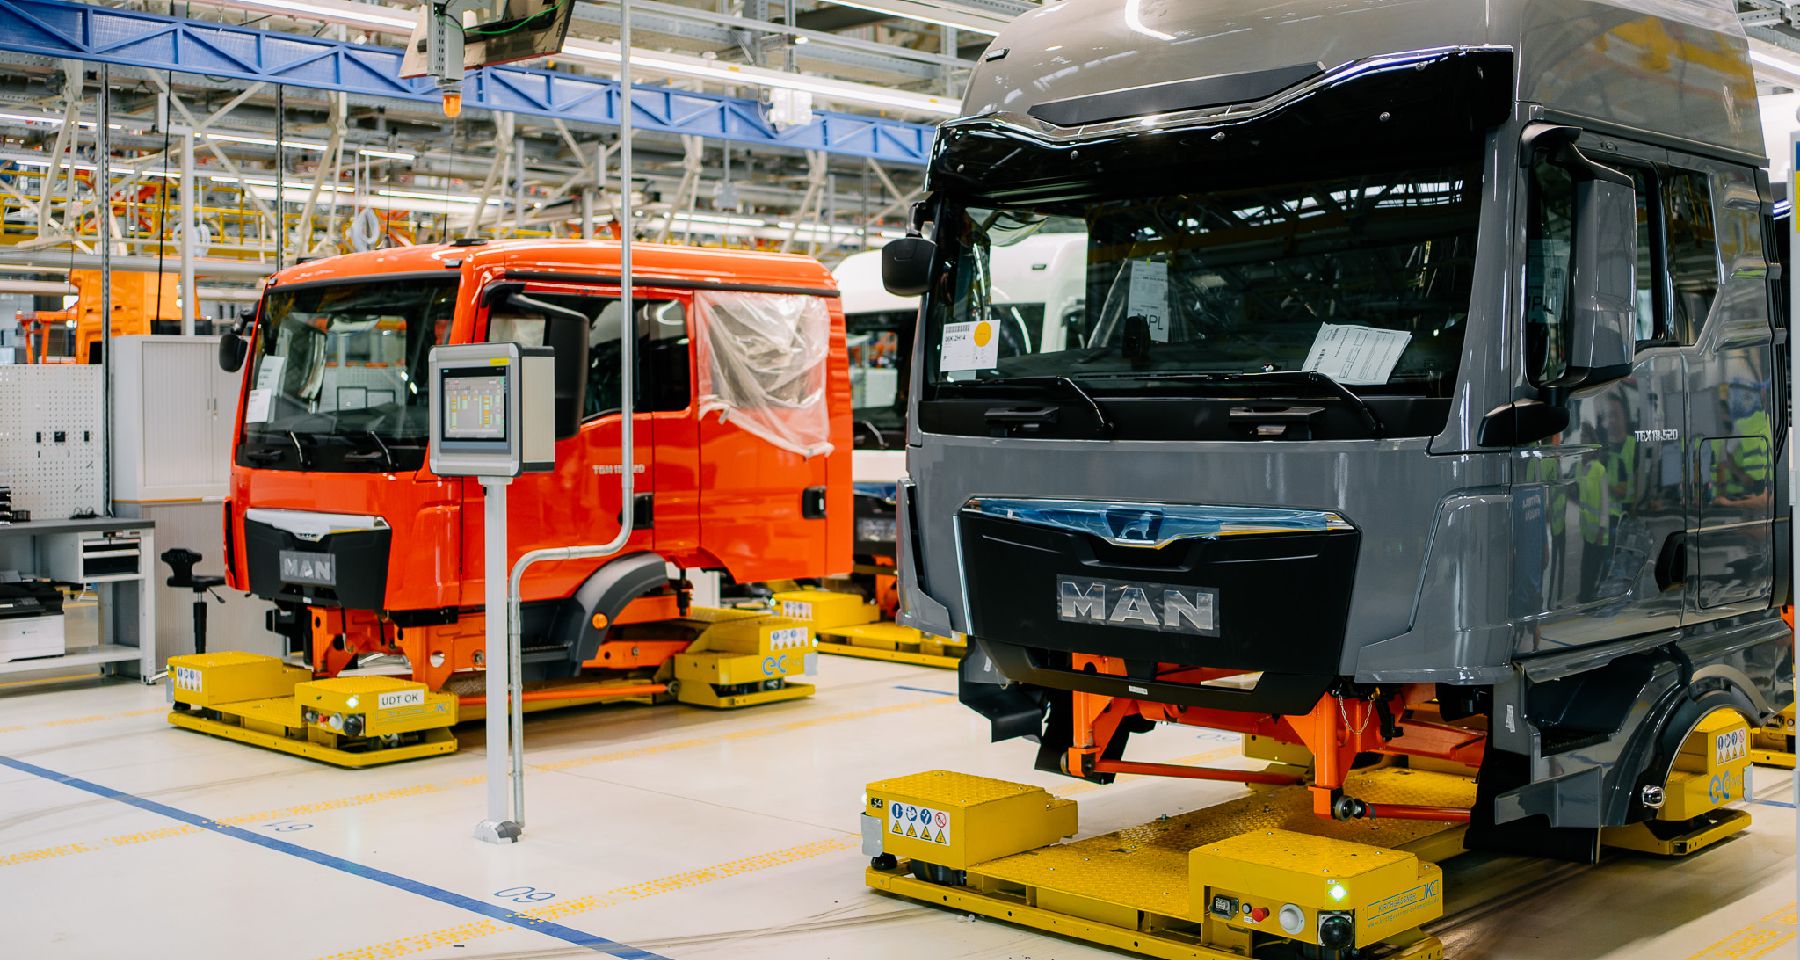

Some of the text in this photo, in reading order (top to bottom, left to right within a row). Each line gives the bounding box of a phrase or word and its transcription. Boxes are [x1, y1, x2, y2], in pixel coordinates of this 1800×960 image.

[284, 558, 331, 581] MAN
[1061, 581, 1214, 631] MAN
[381, 693, 418, 706] UDT OK
